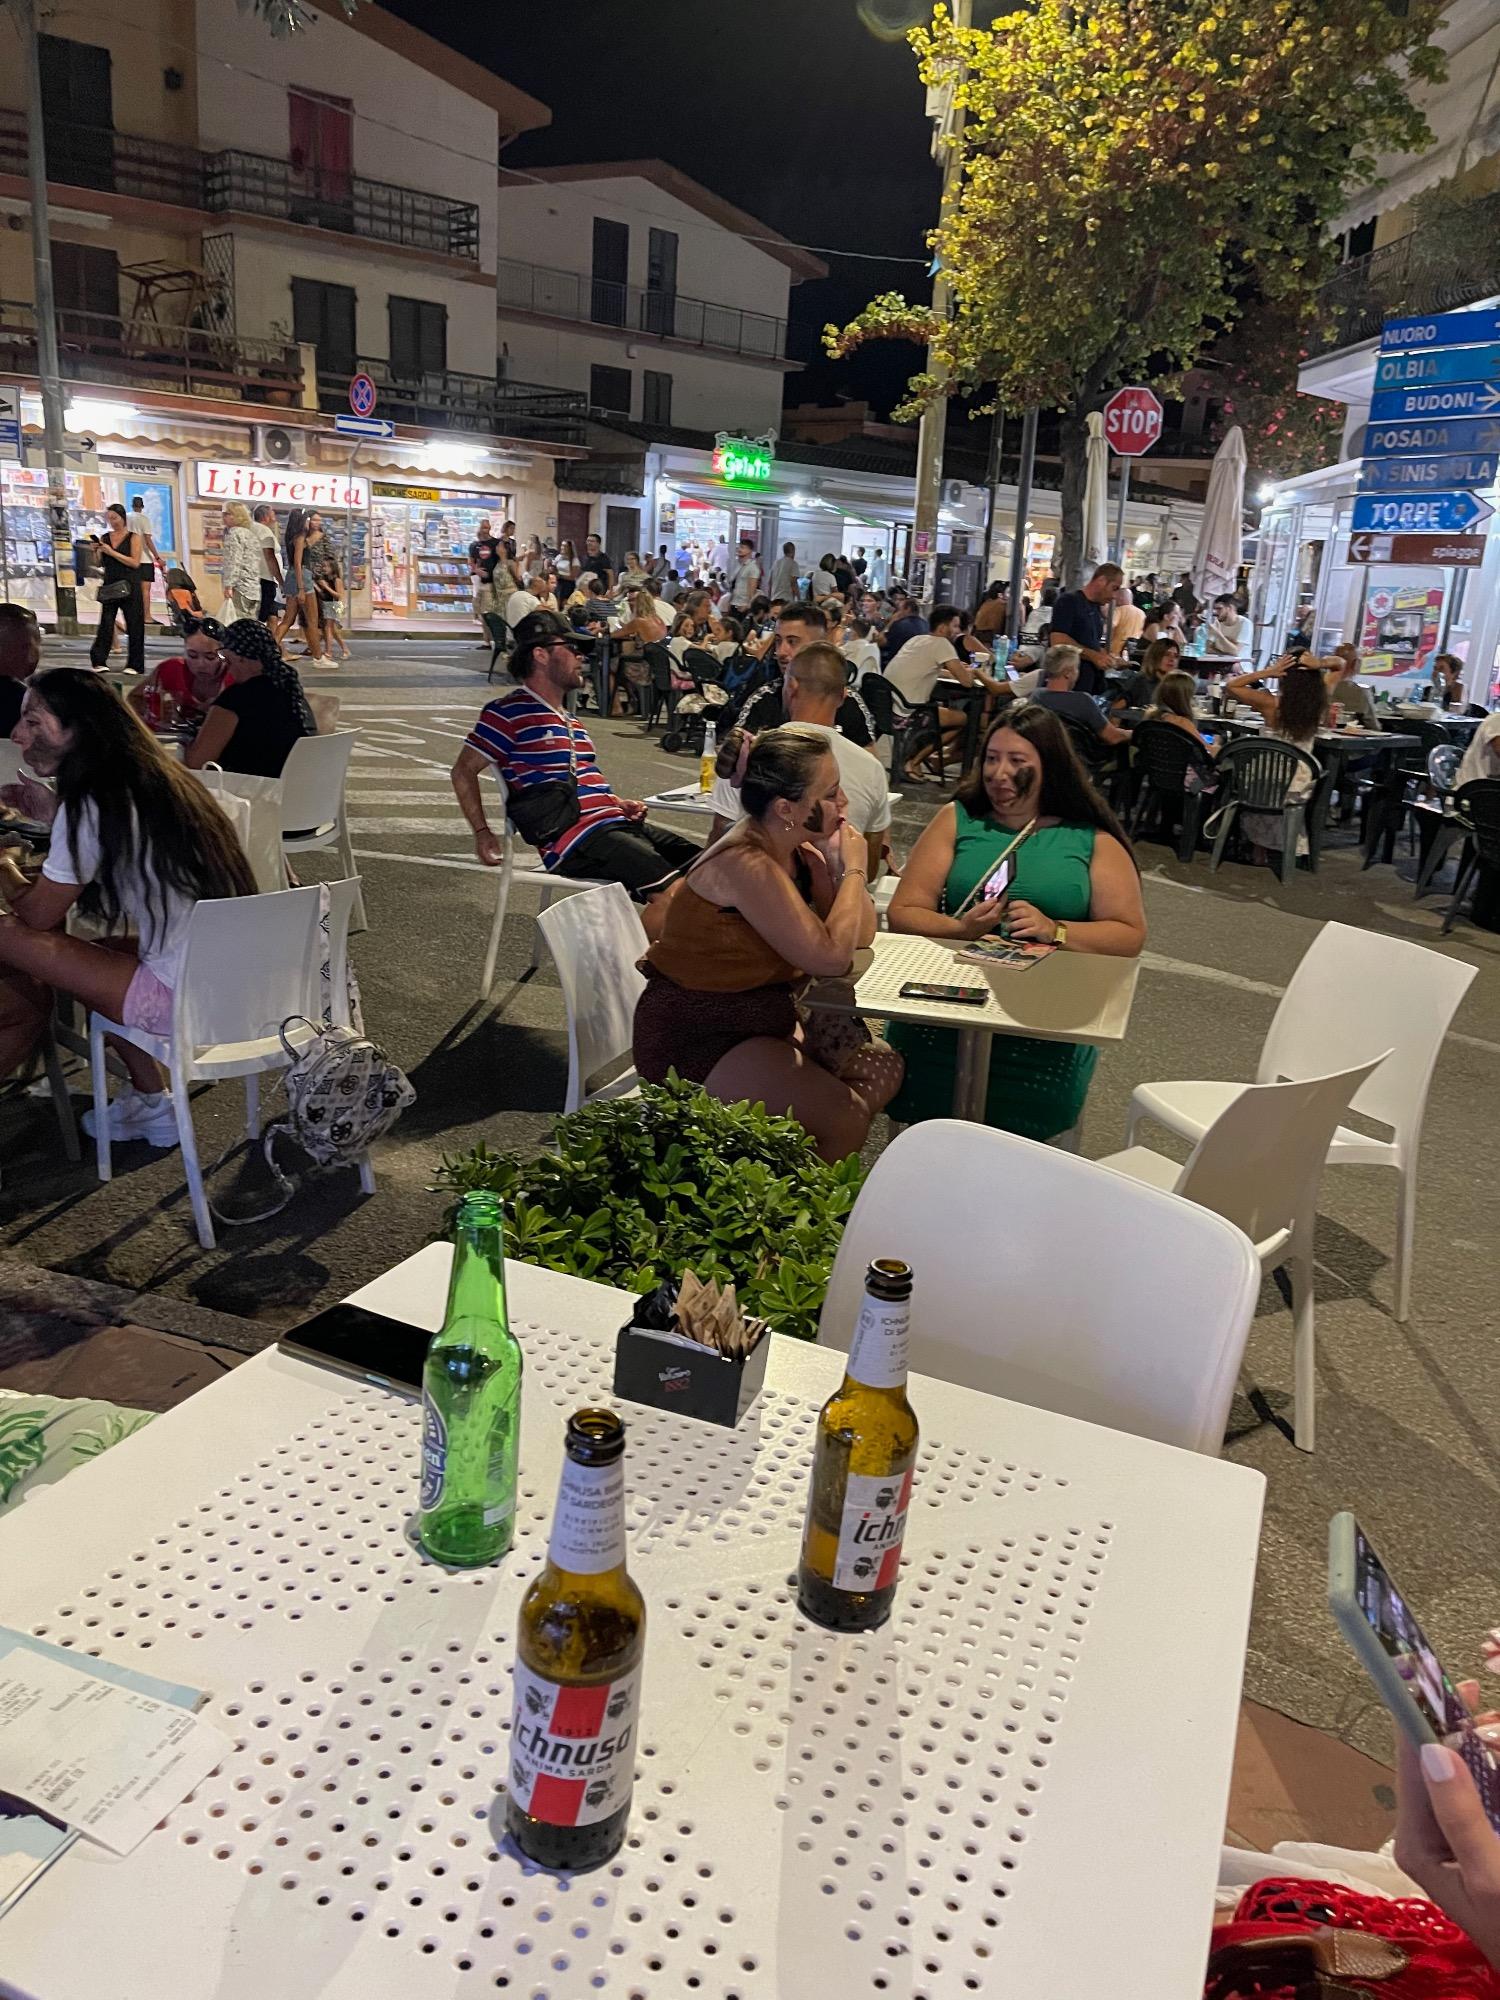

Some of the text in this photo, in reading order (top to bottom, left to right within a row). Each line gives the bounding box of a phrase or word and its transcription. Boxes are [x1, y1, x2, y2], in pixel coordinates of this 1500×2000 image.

[1383, 324, 1437, 345] NUORO
[1381, 359, 1439, 380] OLBIA
[1405, 392, 1475, 411] BUDONI
[1107, 408, 1158, 434] STOP
[1371, 429, 1449, 449] POSADA
[1390, 460, 1491, 482] SINISOLA
[206, 469, 362, 505] Libreria
[407, 489, 432, 501] SARDA
[1432, 544, 1481, 559] spiagge
[525, 1754, 612, 1778] ANIMA SARDA
